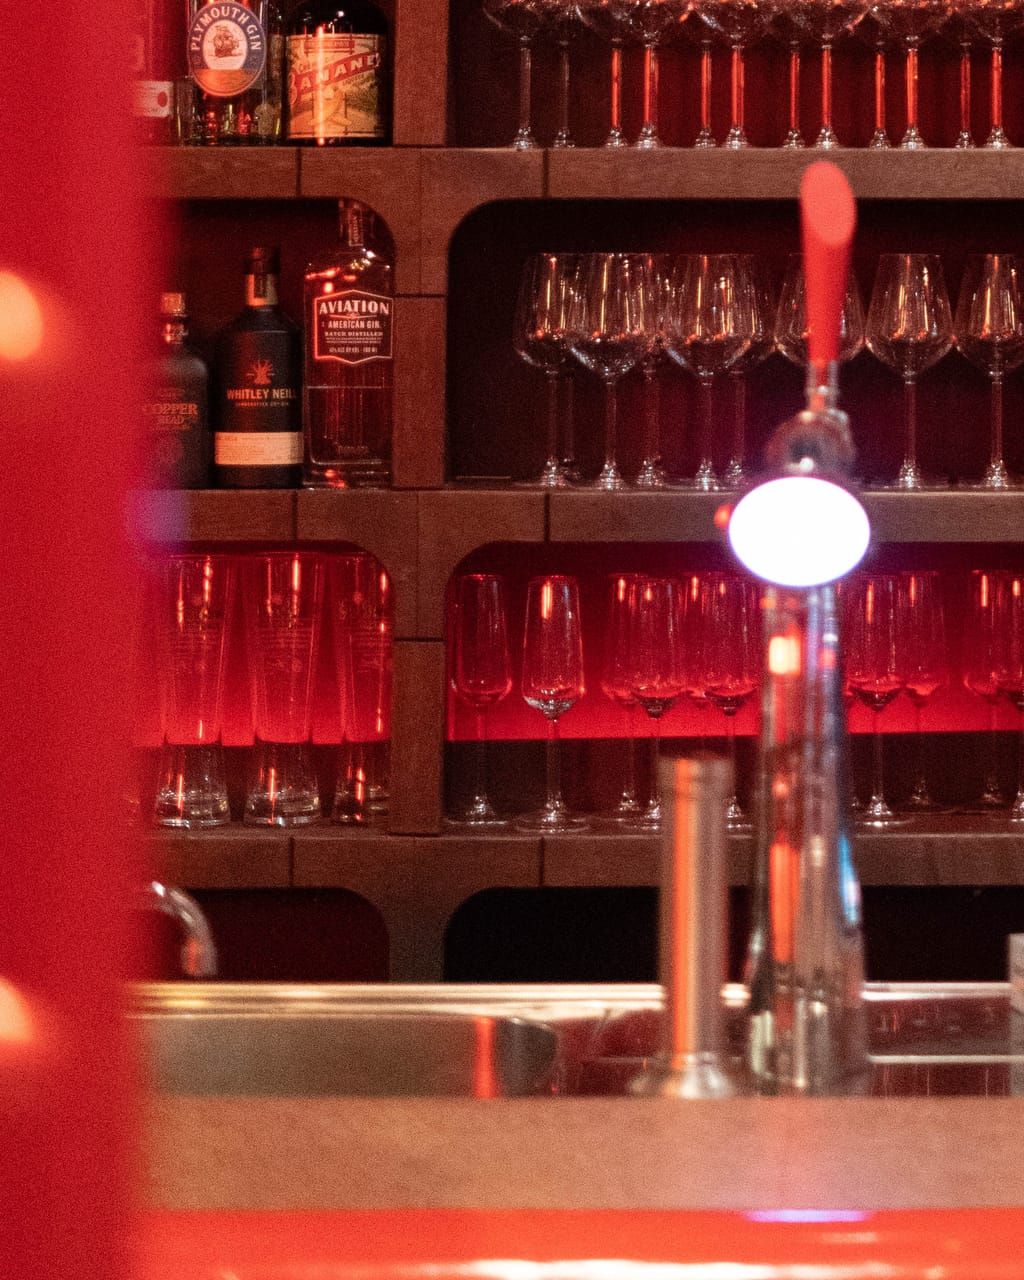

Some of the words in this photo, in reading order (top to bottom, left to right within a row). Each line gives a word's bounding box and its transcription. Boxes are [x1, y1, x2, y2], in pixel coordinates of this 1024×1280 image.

[190, 6, 250, 51] PLYMOUTH
[246, 24, 262, 51] GIN
[319, 300, 389, 315] AVIATION
[328, 320, 365, 329] AMERICAN
[227, 388, 270, 400] WHITLEY
[150, 403, 198, 416] OPPER
